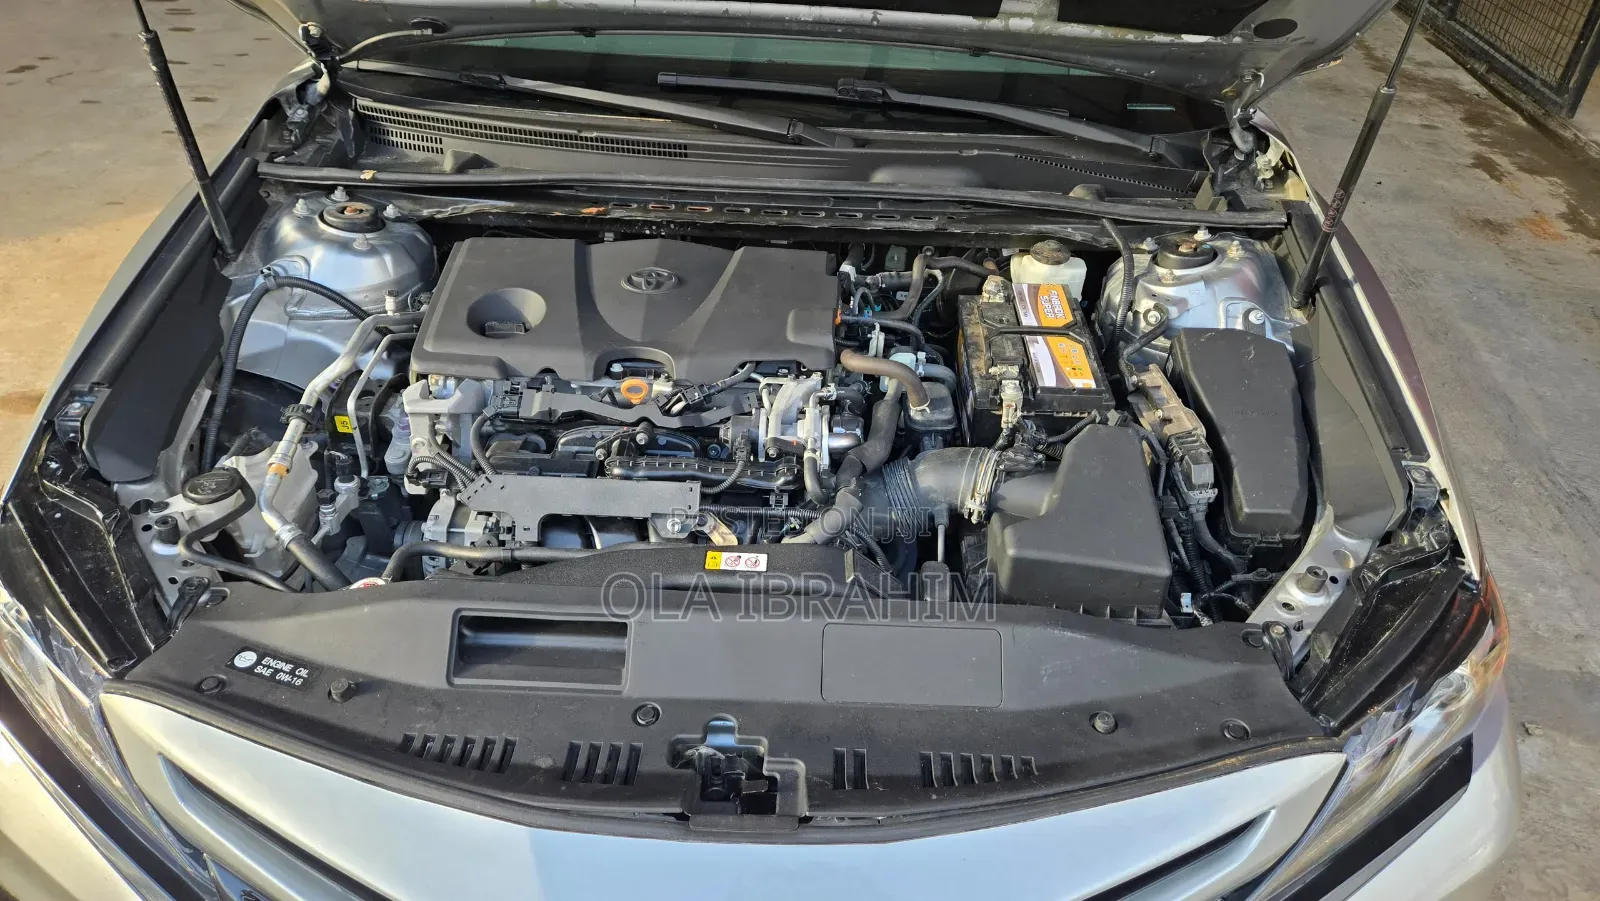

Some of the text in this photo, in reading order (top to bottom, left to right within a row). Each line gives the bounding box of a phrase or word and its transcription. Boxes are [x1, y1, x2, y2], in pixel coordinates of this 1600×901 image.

[1040, 295, 1055, 318] SUPER
[340, 421, 350, 430] J5
[253, 665, 303, 686] SAE 0W-16
[261, 657, 309, 677] ENGINE OIL
